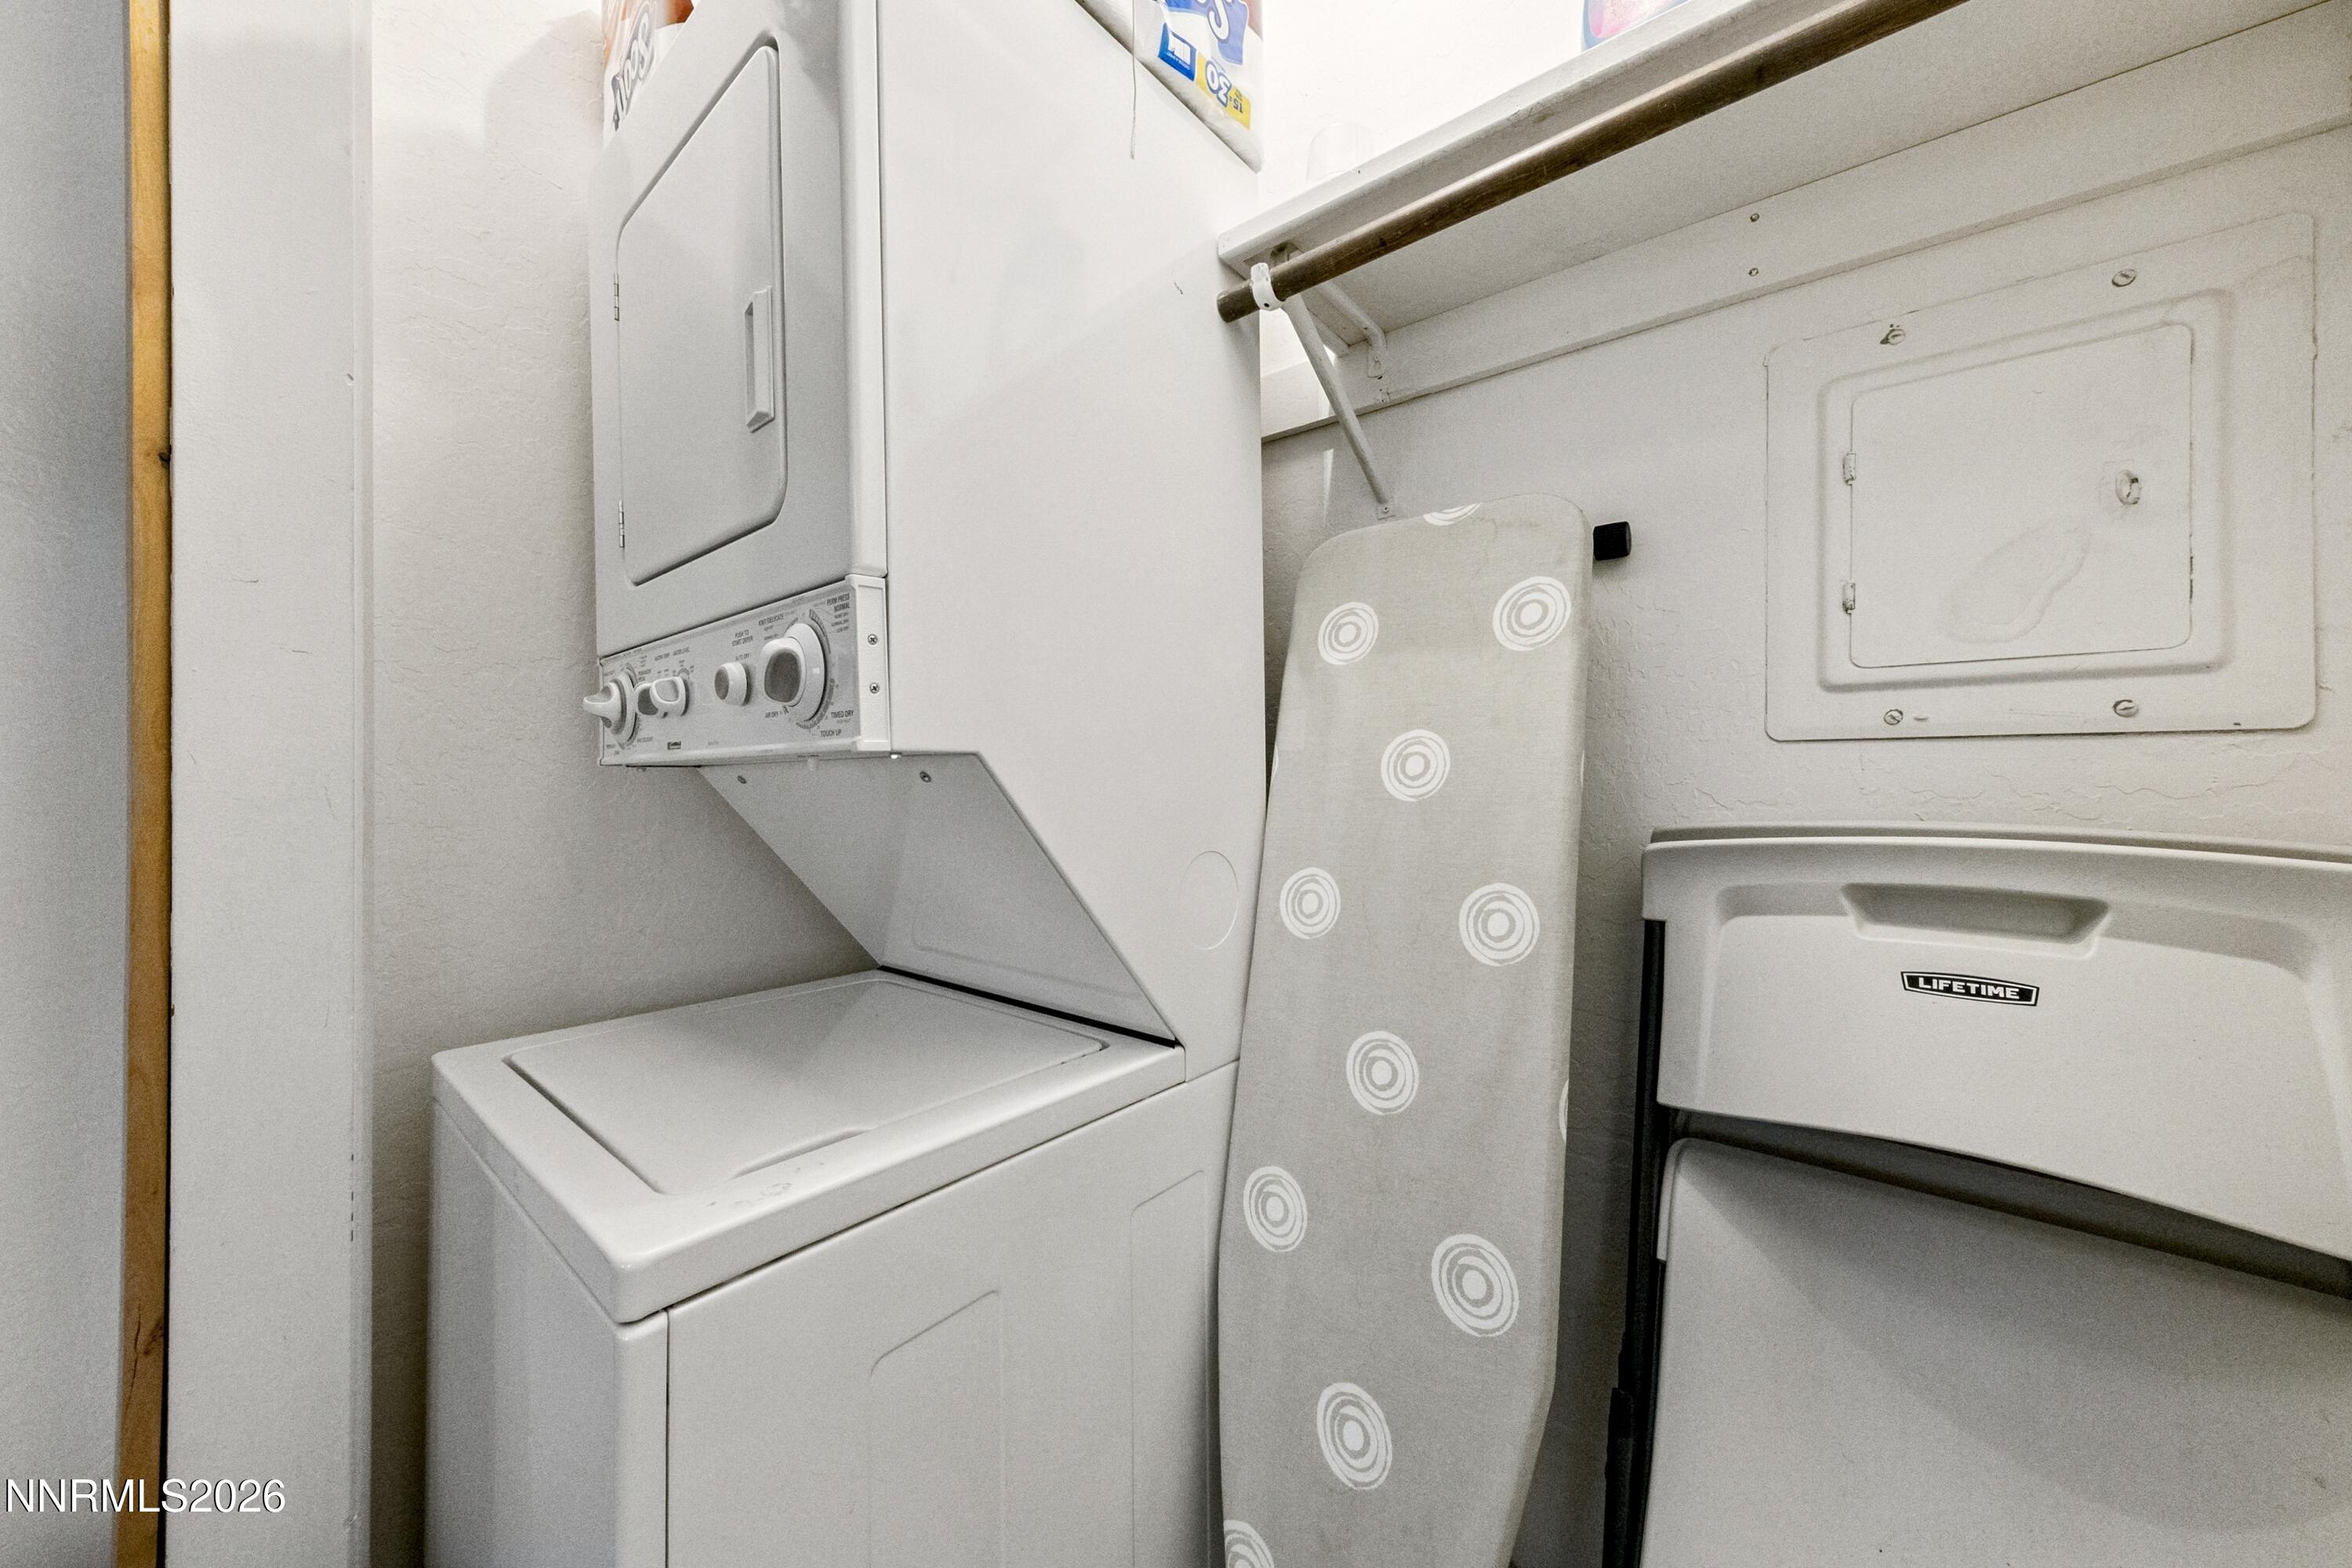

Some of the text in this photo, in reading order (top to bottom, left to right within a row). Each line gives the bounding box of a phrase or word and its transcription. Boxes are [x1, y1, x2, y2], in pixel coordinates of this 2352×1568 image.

[1205, 60, 1232, 108] 30
[831, 709, 855, 719] TIMED DRY
[835, 728, 842, 737] UP
[1918, 977, 2020, 1000] LIFETIME
